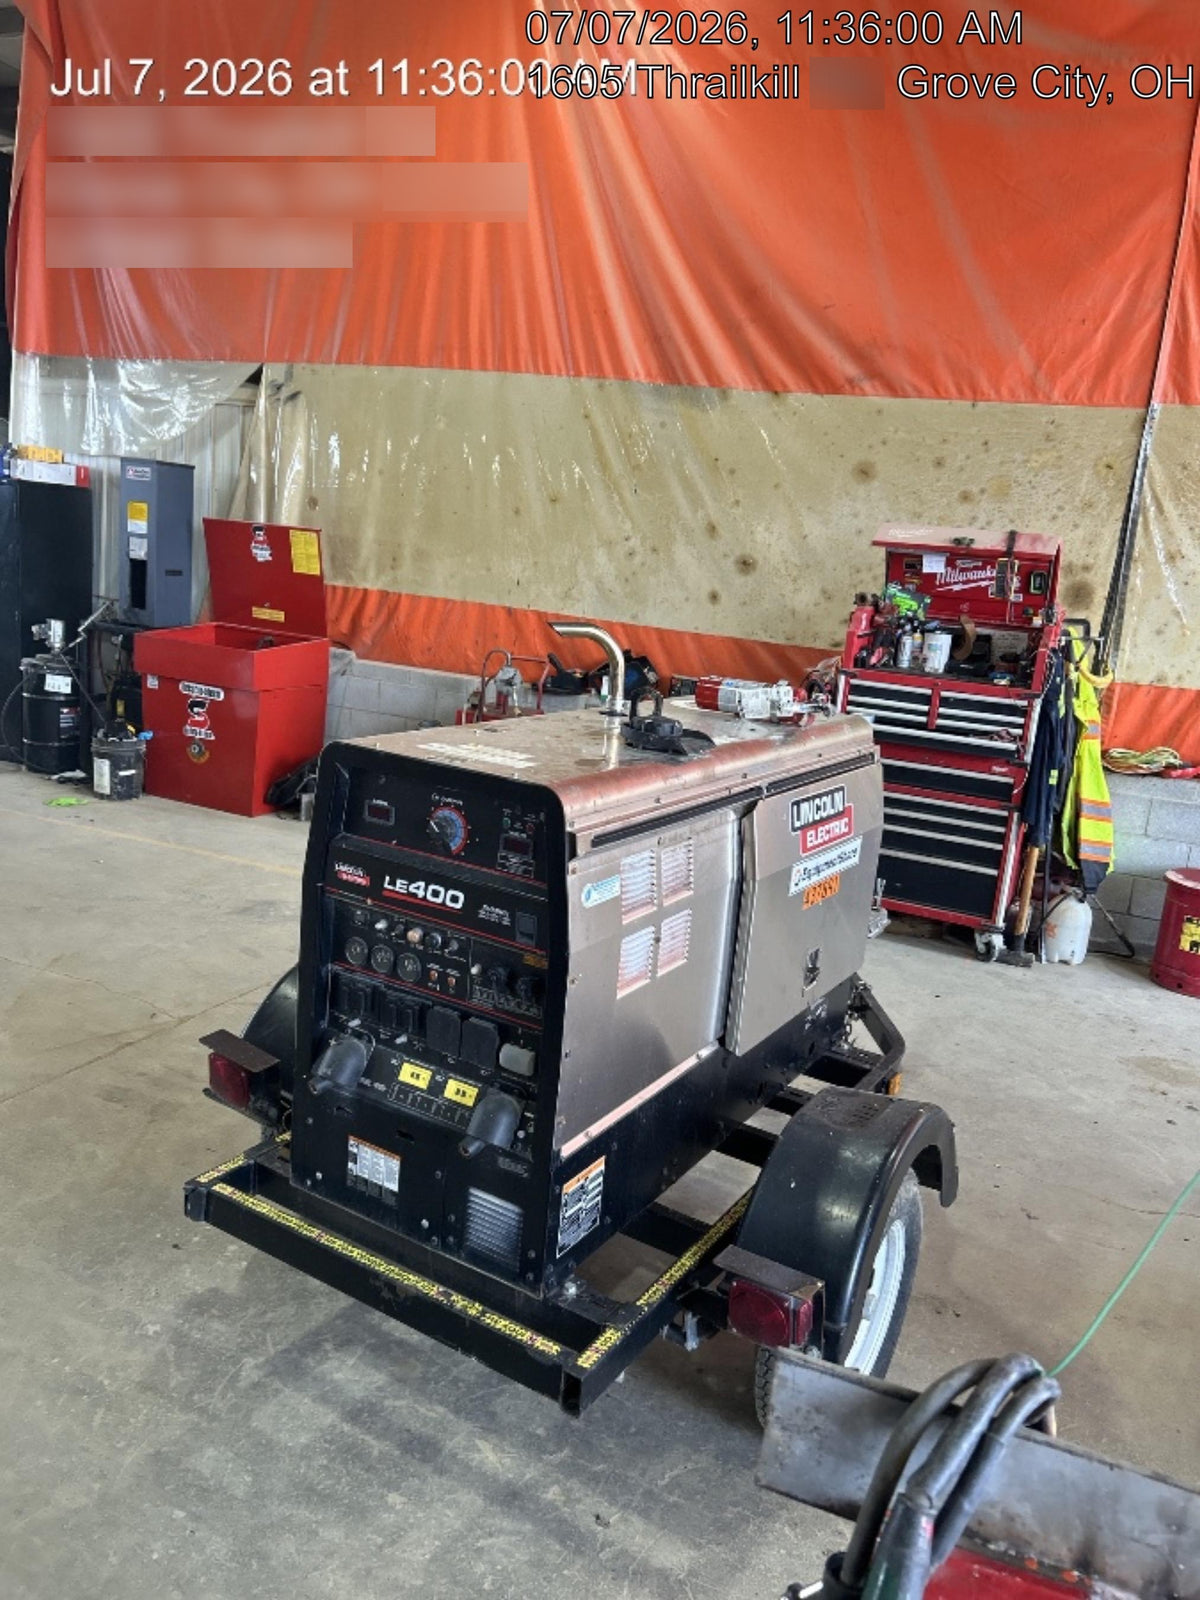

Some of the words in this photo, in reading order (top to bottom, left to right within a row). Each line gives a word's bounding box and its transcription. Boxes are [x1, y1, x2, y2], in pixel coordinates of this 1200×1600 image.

[793, 790, 844, 827] LINCOLN
[807, 817, 849, 848] ELECTRIC
[383, 875, 465, 909] LE400
